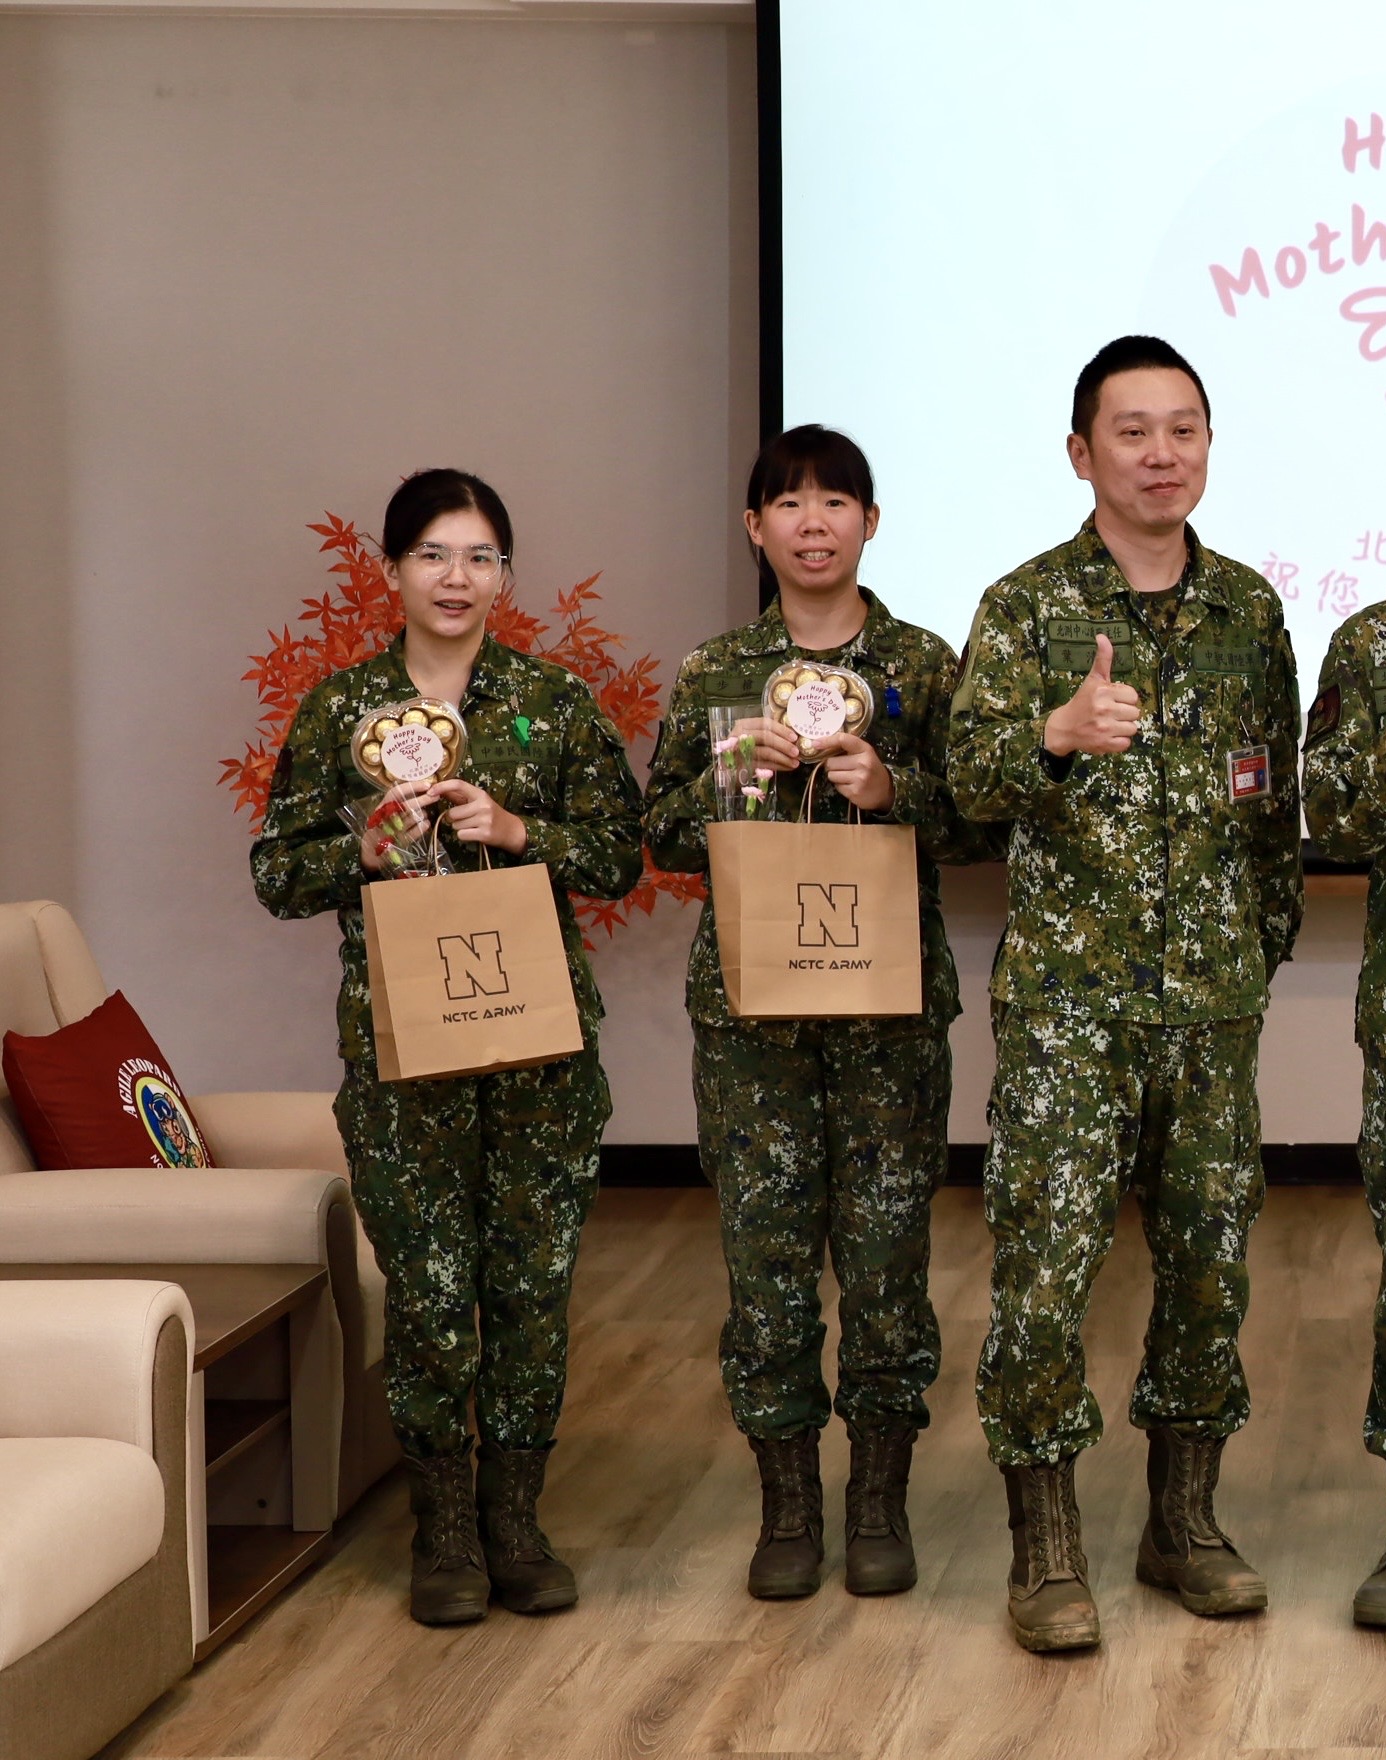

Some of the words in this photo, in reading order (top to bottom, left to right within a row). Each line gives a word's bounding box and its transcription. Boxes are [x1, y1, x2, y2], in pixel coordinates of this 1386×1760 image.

[810, 685, 832, 696] Happy
[828, 699, 840, 711] Day
[393, 729, 415, 739] Happy
[417, 735, 431, 744] Day
[788, 960, 825, 970] NCTC
[828, 960, 873, 970] ARMY
[442, 1010, 479, 1024] NCTC
[483, 1003, 526, 1019] ARMY
[118, 1067, 138, 1119] AGILE
